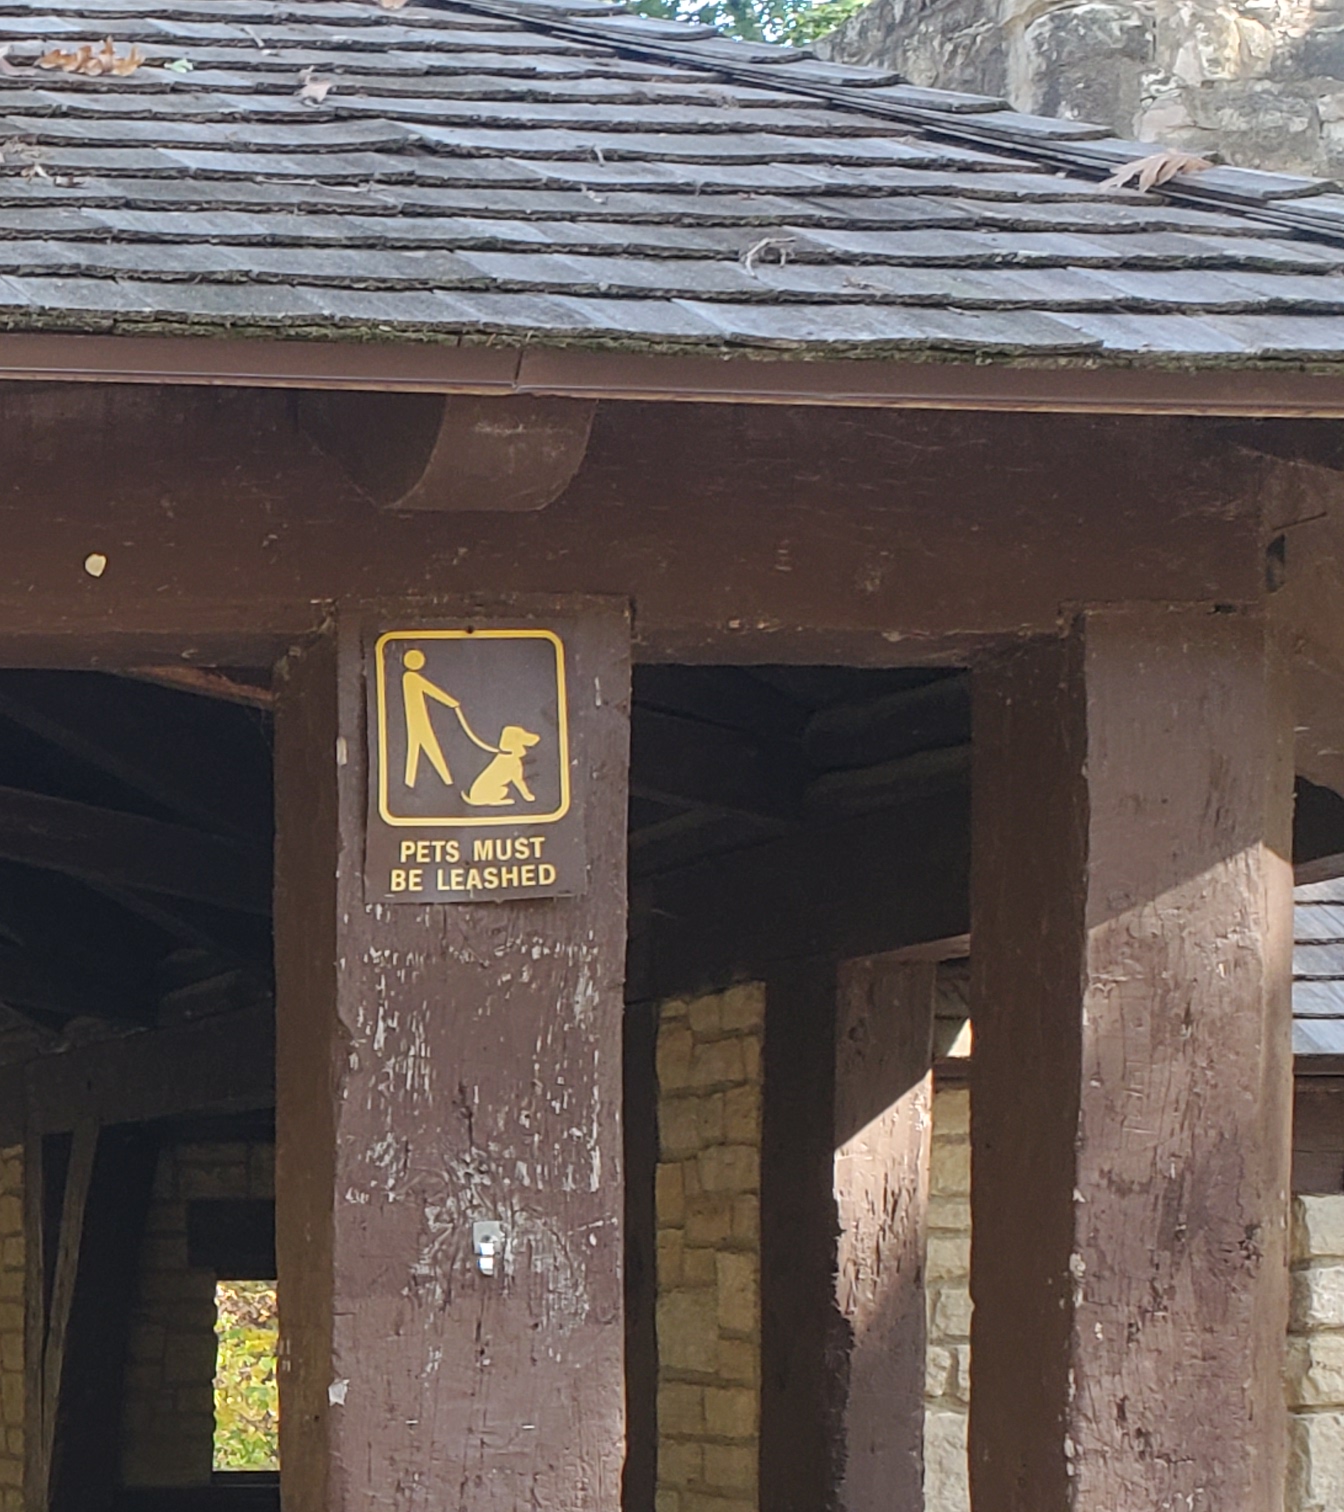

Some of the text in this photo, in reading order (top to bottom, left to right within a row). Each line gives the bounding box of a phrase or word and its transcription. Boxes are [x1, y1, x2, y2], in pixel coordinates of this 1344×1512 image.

[400, 836, 545, 863] PETS MUST
[390, 863, 557, 892] BE LEASHED
